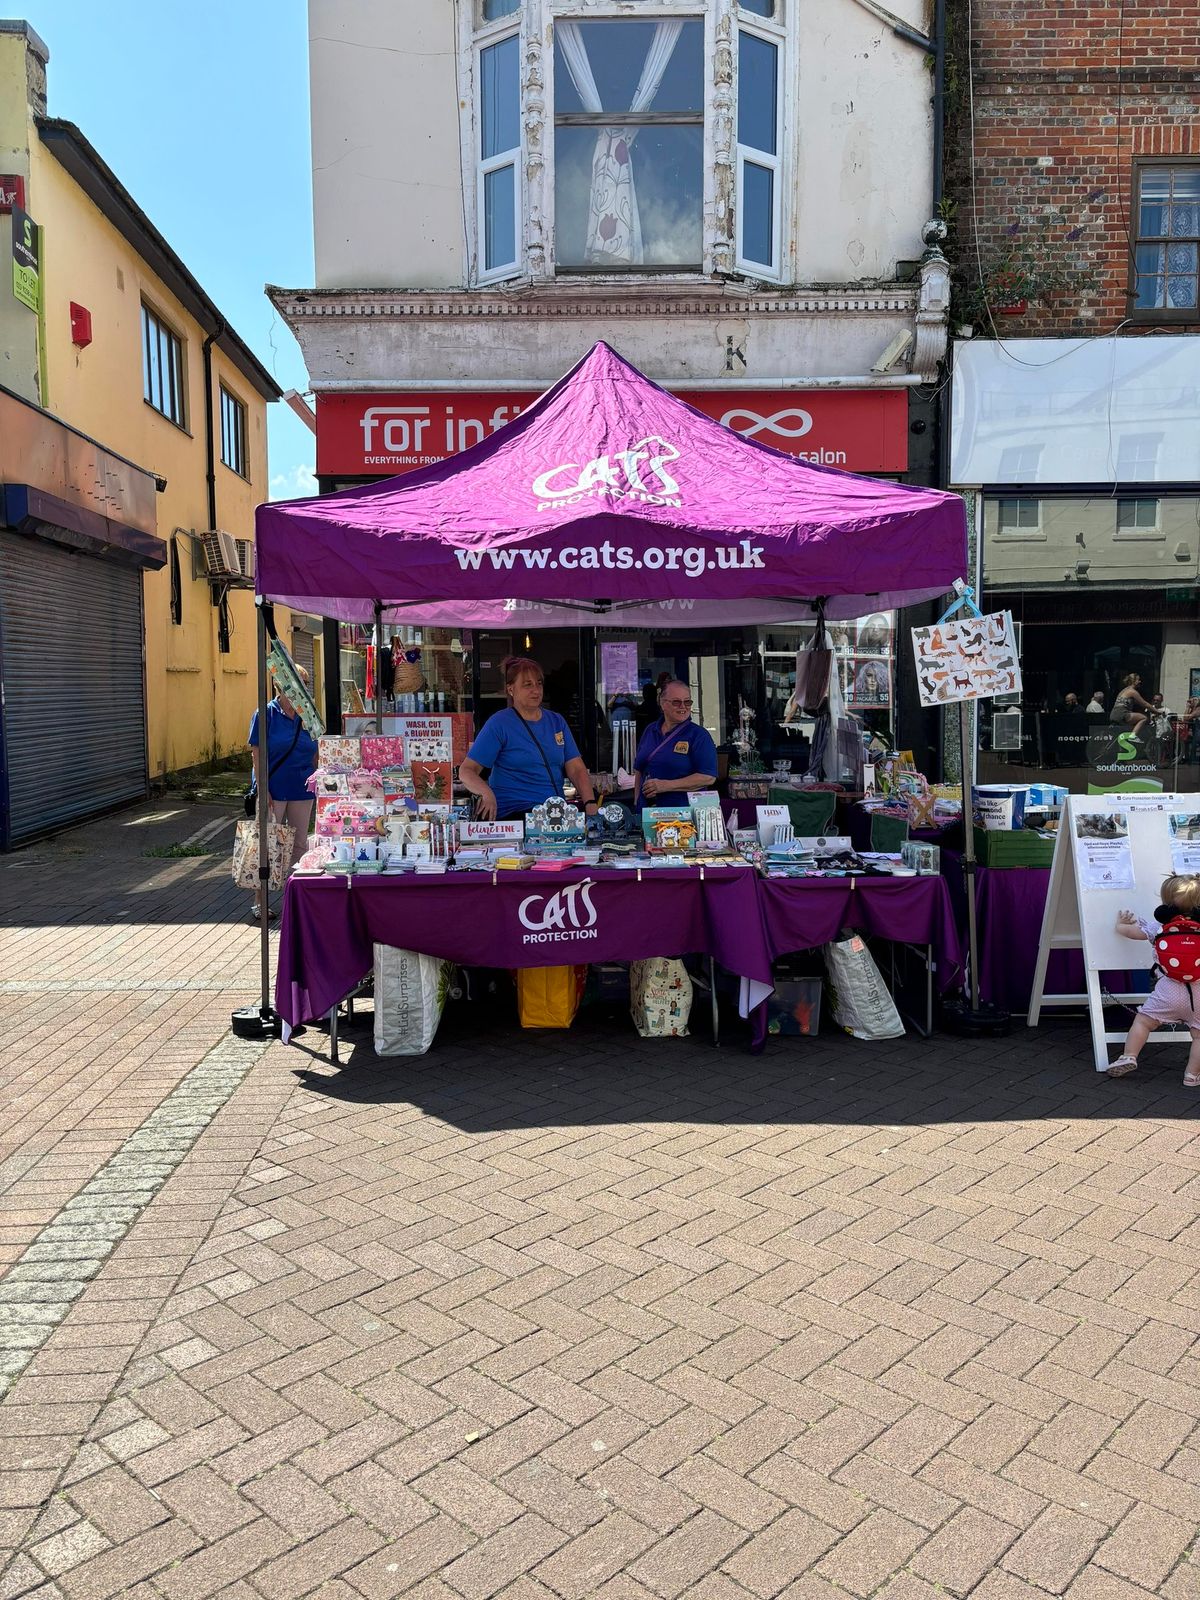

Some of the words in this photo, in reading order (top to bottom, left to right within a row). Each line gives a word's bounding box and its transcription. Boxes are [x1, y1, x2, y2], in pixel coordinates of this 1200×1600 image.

[360, 407, 430, 452] for
[364, 456, 418, 464] EVERYTHING
[420, 456, 444, 464] FROM
[799, 447, 846, 464] salon
[532, 436, 681, 498] CATS
[537, 487, 682, 513] PROTECTION
[454, 540, 766, 578] www.cats.org.uk
[1096, 763, 1157, 772] southernbrook
[467, 823, 496, 837] feline
[496, 825, 515, 833] FINE
[541, 824, 570, 833] MEOW
[518, 877, 597, 931] CATS
[523, 929, 598, 944] PROTECTION
[397, 958, 411, 1035] #LidlSurprises
